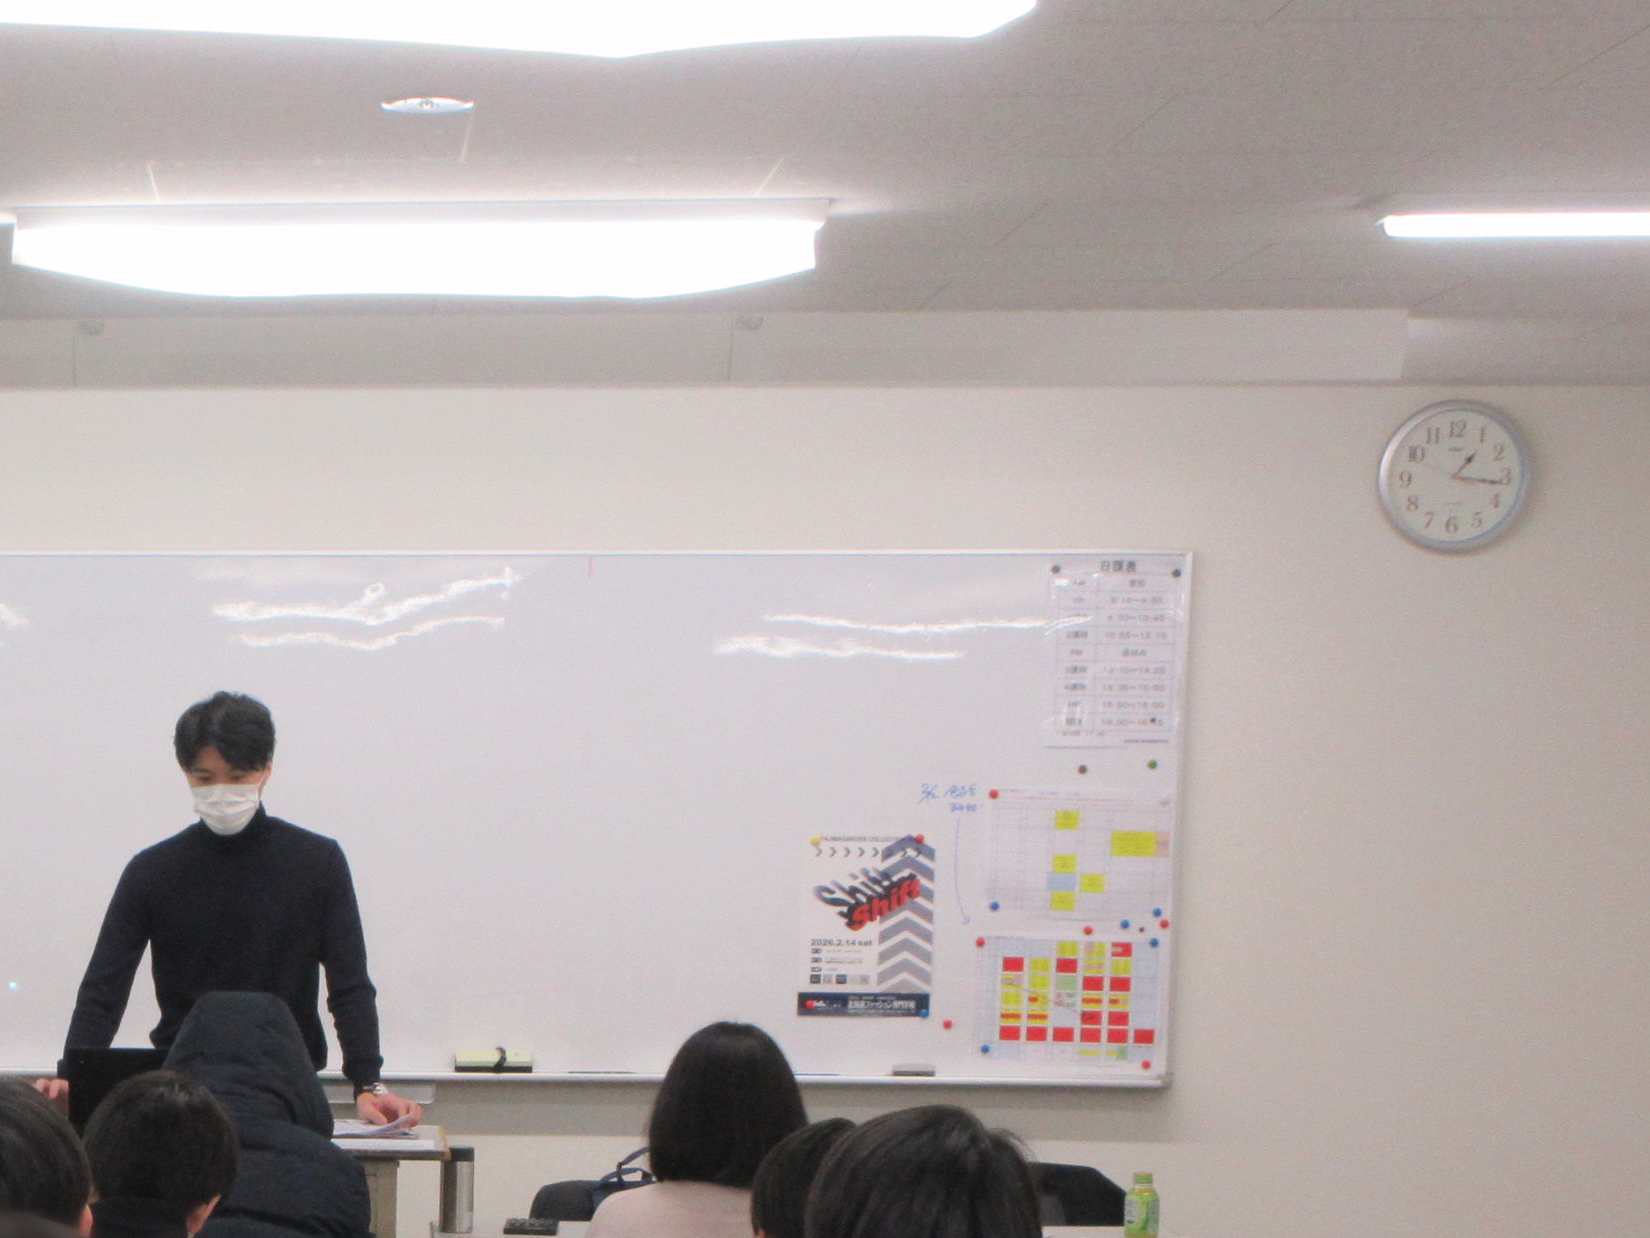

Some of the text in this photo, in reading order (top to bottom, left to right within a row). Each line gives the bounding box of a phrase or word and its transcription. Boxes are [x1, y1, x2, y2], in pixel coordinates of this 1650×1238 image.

[1427, 427, 1440, 444] 11
[1450, 420, 1466, 437] 12
[1479, 427, 1486, 443] 1
[1408, 445, 1425, 462] 10
[1493, 443, 1504, 461] 2
[1400, 471, 1412, 487] 9
[1406, 496, 1418, 511] 8
[1491, 493, 1499, 508] 4
[1424, 512, 1435, 528] 7
[1446, 516, 1458, 533] 6
[1471, 512, 1482, 527] 5
[811, 938, 873, 947] 2026.2.14 sat
